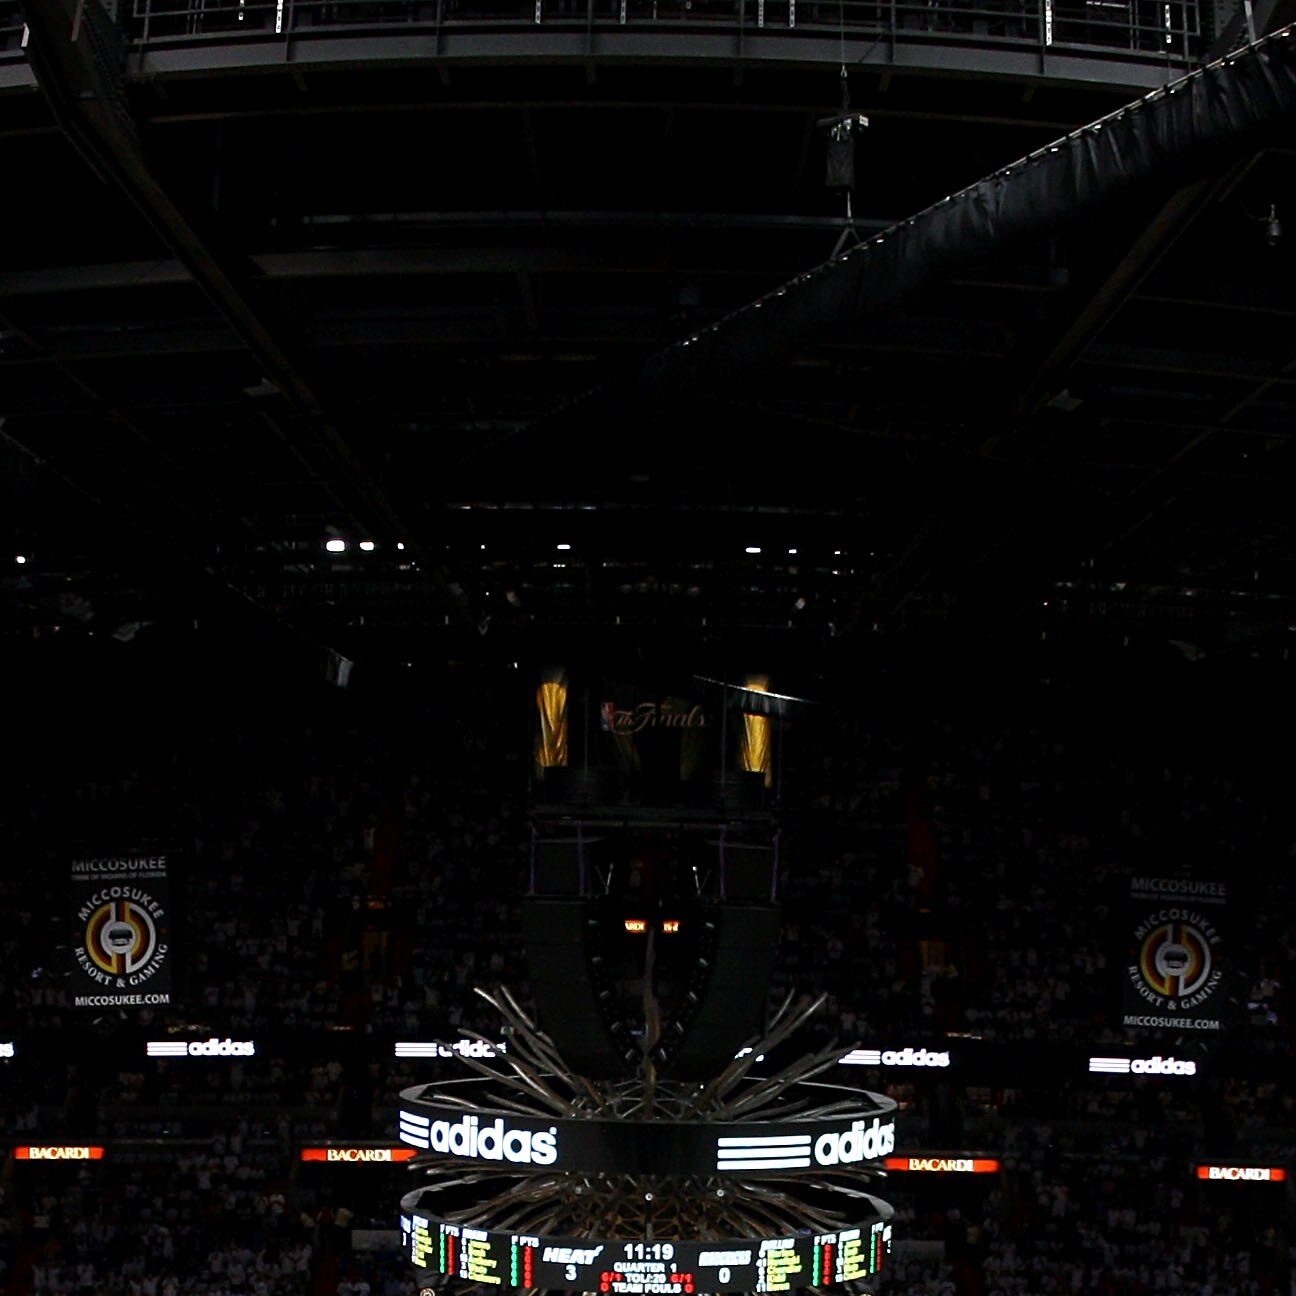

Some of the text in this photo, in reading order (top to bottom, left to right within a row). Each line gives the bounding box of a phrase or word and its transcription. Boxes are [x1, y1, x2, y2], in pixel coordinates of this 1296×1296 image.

[71, 855, 167, 873] MICCOSUKEE
[1129, 876, 1228, 896] MICCOSUKEE
[77, 885, 165, 921] MICCOSUKEE
[1133, 907, 1224, 944] MICCOSUKEE
[74, 943, 169, 988] RESORT & GAMING
[1128, 966, 1223, 1011] RESORT & GAMING
[74, 993, 170, 1007] MICCOSUKEE.COM
[1123, 1015, 1220, 1030] MICCOSUKEE.COM
[188, 1038, 256, 1056] adidas
[881, 1047, 951, 1067] adidas
[1130, 1056, 1197, 1076] adidas
[430, 1114, 558, 1166] adidas
[814, 1117, 896, 1166] adidas
[29, 1146, 90, 1160] BACARDI
[327, 1148, 392, 1162] BACARDI
[908, 1159, 974, 1172] BACARDI
[1208, 1167, 1271, 1181] BACARDI
[542, 1242, 675, 1265] HEAT 11:19
[564, 1261, 731, 1284] 3 QUARTER 1 0
[599, 1282, 696, 1294] 0 TEAM FOULS 0
